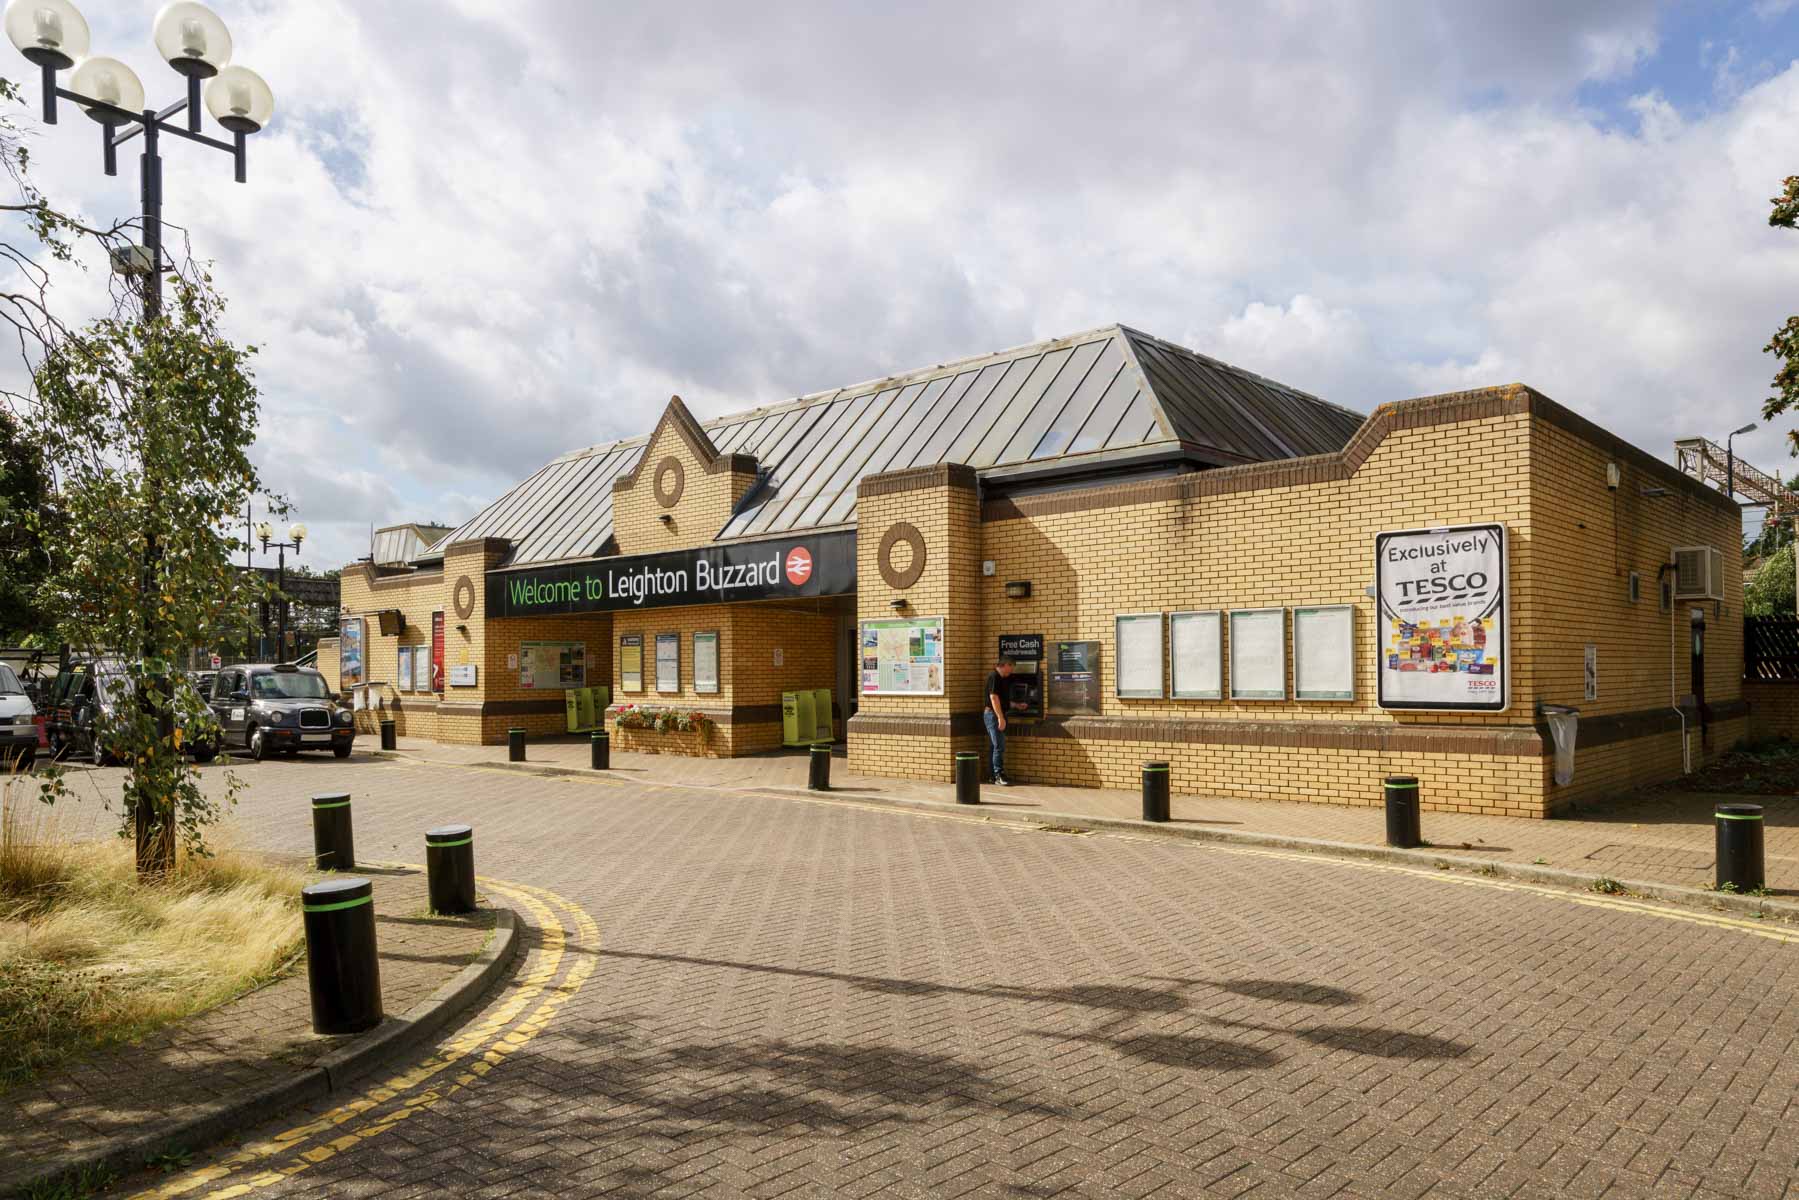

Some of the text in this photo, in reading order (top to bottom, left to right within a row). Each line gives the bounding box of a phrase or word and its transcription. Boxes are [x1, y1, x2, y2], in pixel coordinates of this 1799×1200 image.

[1388, 535, 1488, 562] Exclusively
[510, 551, 780, 605] Welcome to Leighton Buzzard
[1430, 559, 1448, 573] at
[1395, 572, 1488, 597] TESCO
[1001, 639, 1040, 649] Free Cash
